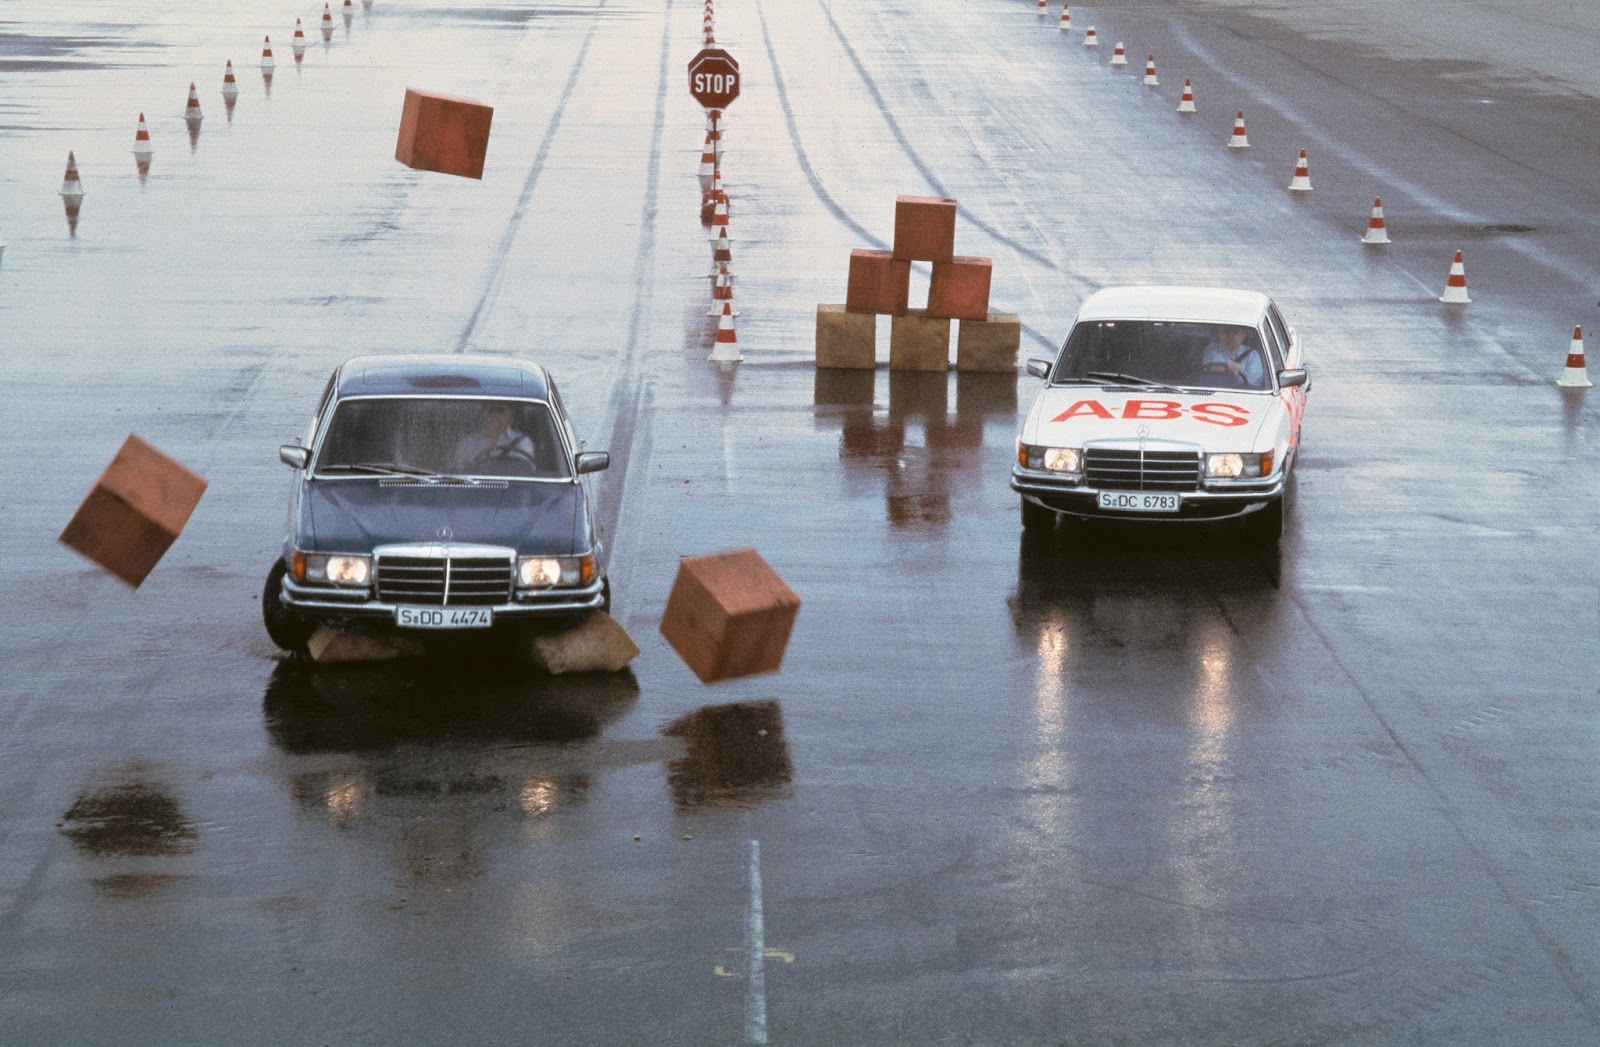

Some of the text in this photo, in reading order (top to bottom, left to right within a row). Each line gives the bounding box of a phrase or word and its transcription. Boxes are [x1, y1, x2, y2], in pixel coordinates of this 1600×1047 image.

[695, 73, 735, 94] STOP
[1143, 496, 1176, 509] 6783
[450, 611, 488, 625] 4474
